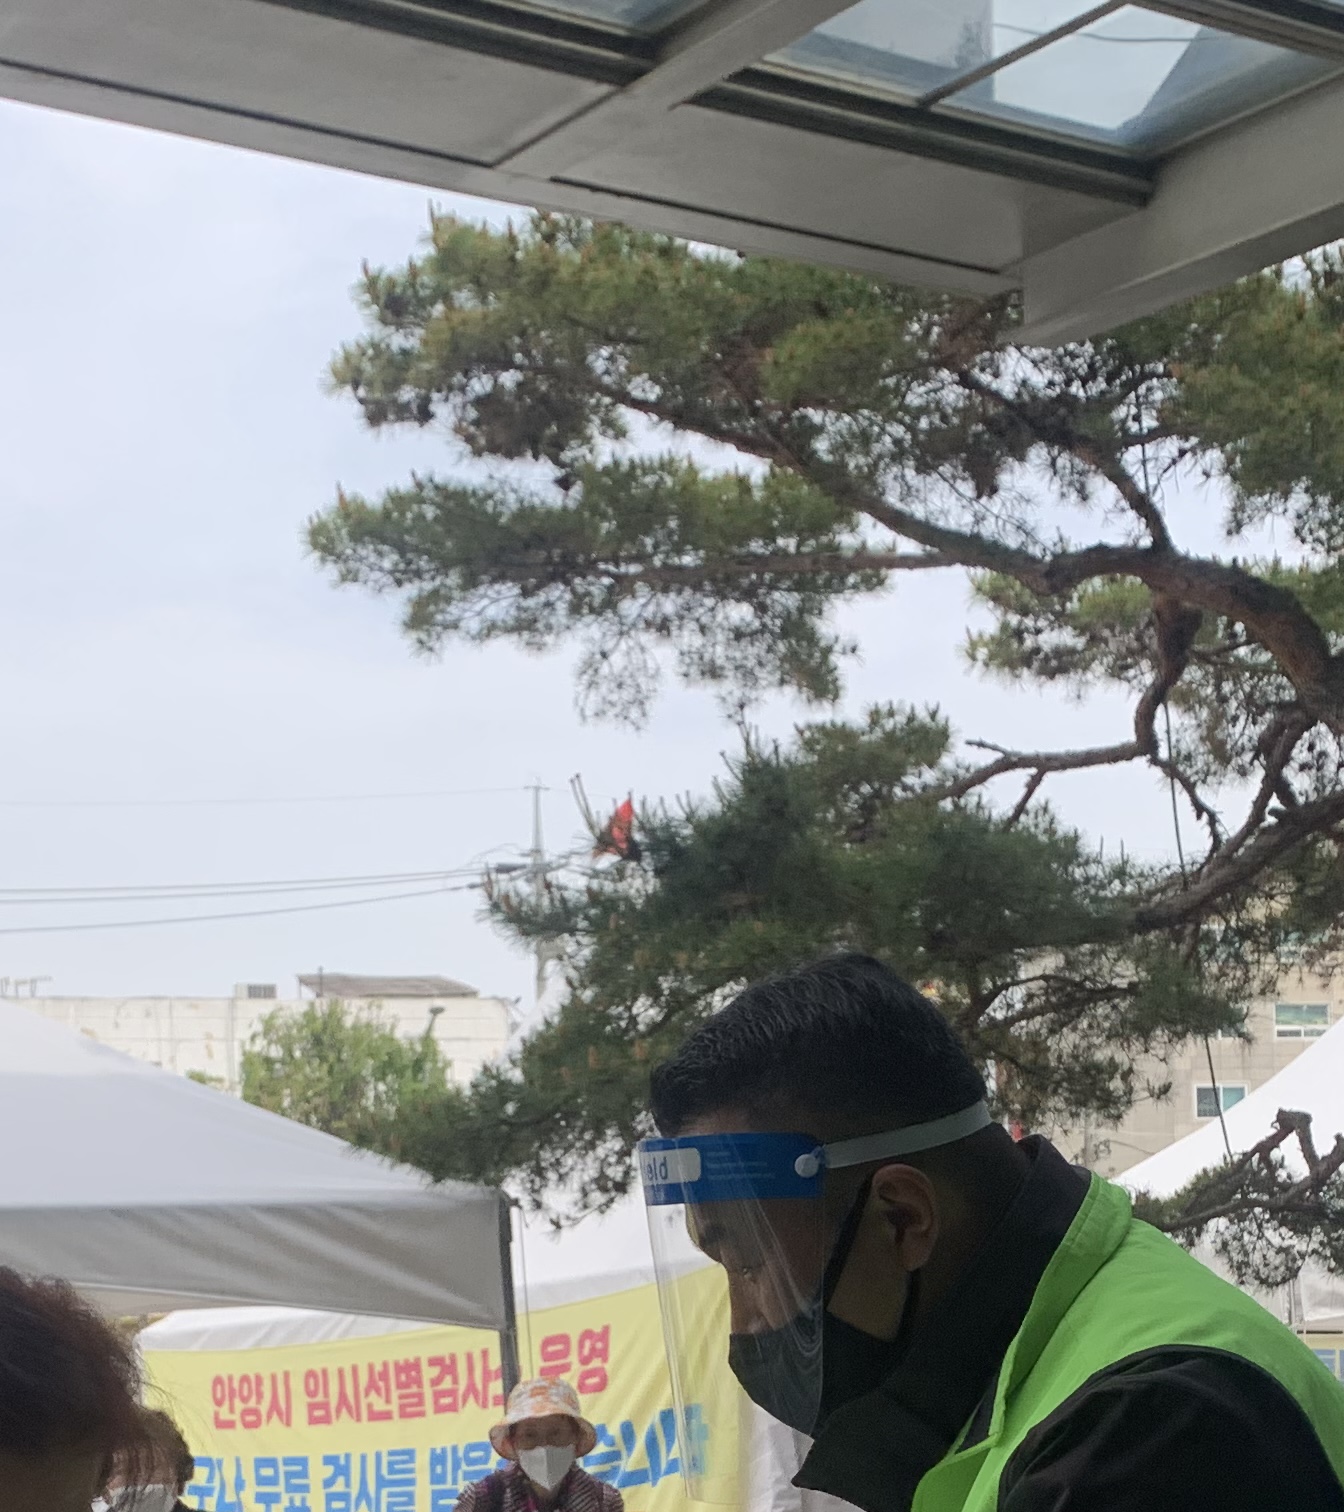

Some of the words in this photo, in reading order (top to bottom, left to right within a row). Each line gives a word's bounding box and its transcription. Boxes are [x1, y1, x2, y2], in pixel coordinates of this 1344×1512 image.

[644, 1157, 668, 1181] eld
[212, 1370, 292, 1430] 안양시
[539, 1324, 610, 1395] 운영
